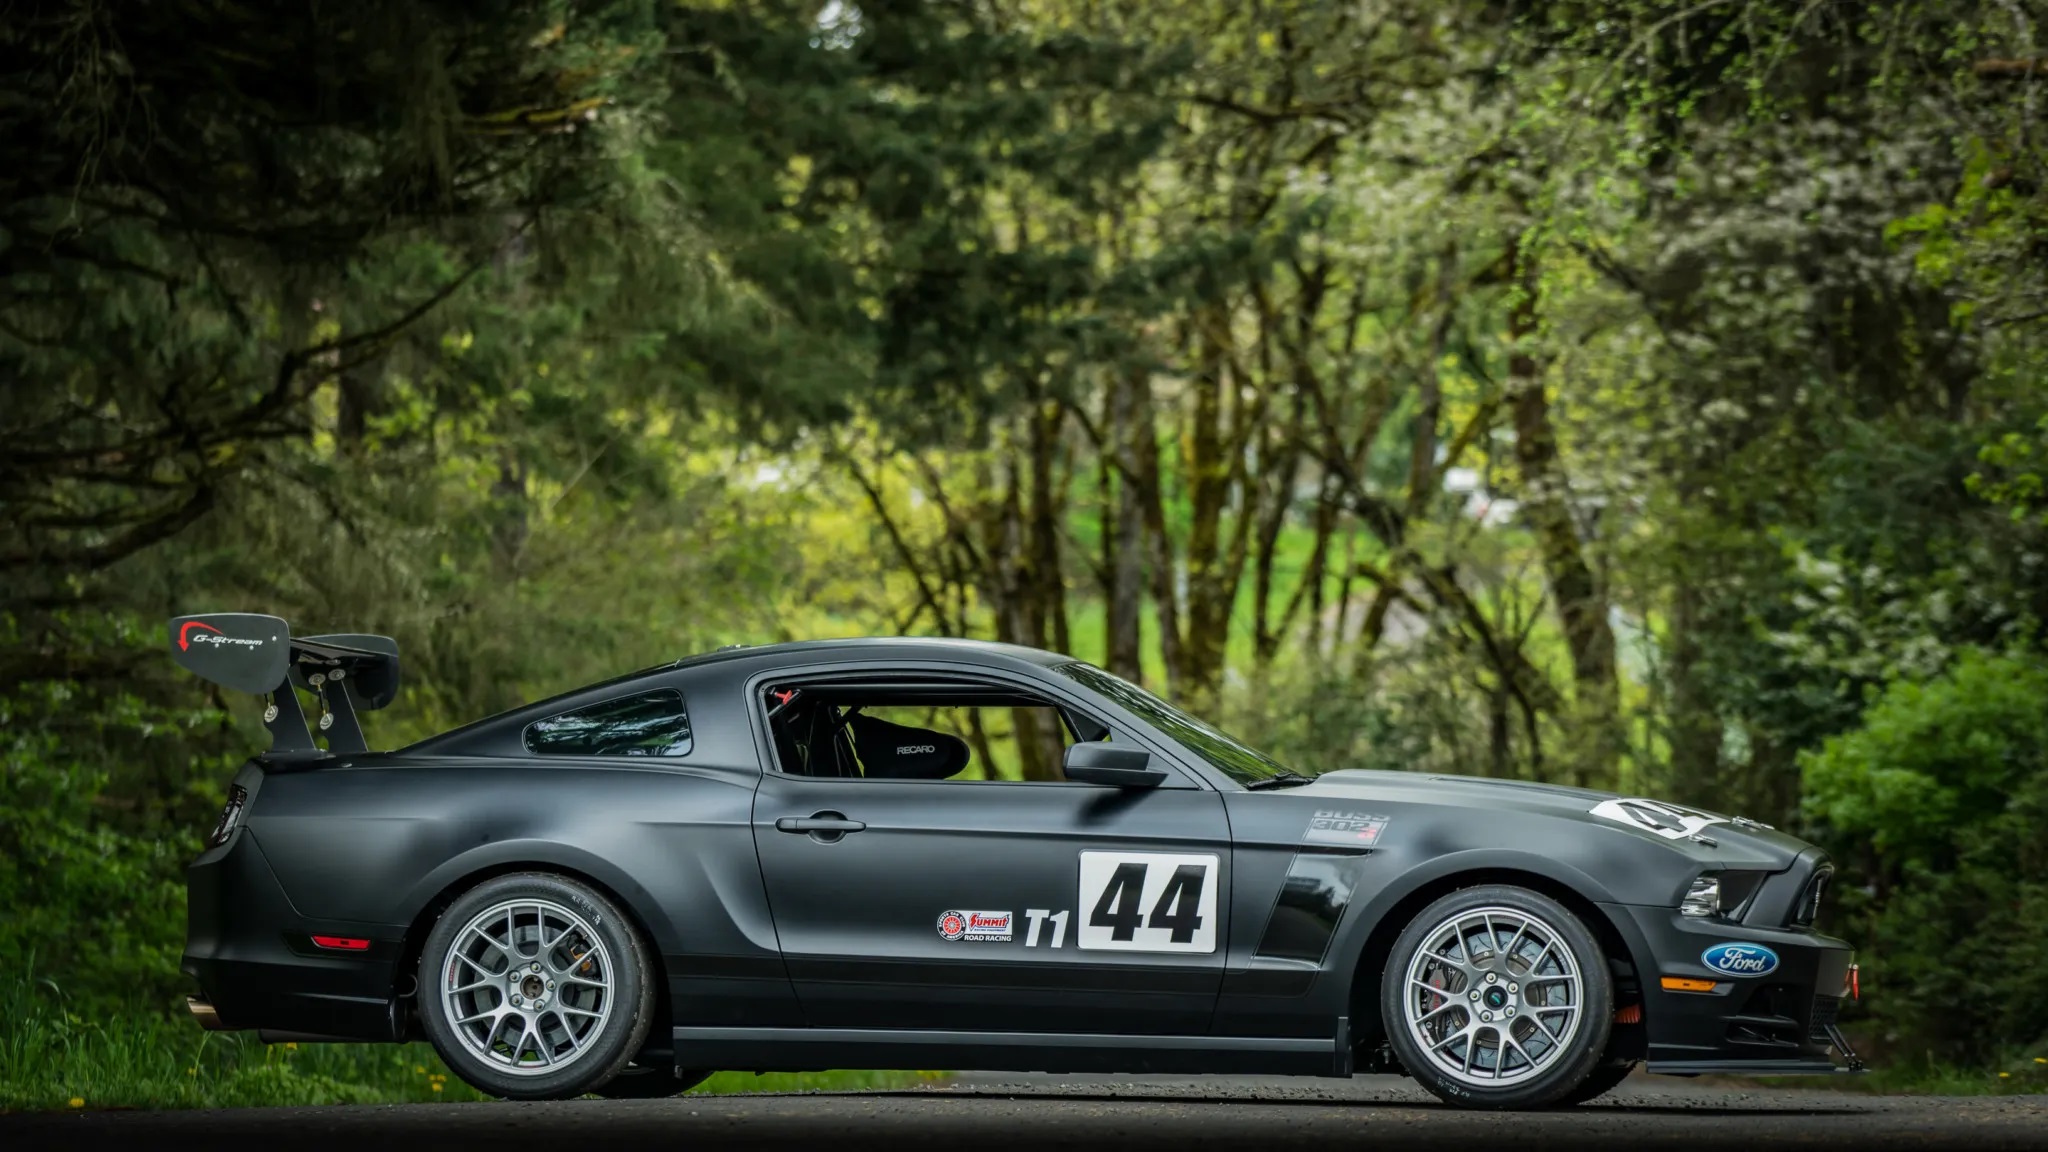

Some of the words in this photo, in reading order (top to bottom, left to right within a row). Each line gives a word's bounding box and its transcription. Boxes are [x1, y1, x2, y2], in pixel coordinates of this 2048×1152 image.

[193, 634, 264, 646] G-Stream
[896, 745, 936, 755] RECARO
[1088, 862, 1208, 944] 44
[1024, 908, 1070, 949] T1
[1719, 947, 1766, 972] Ford
